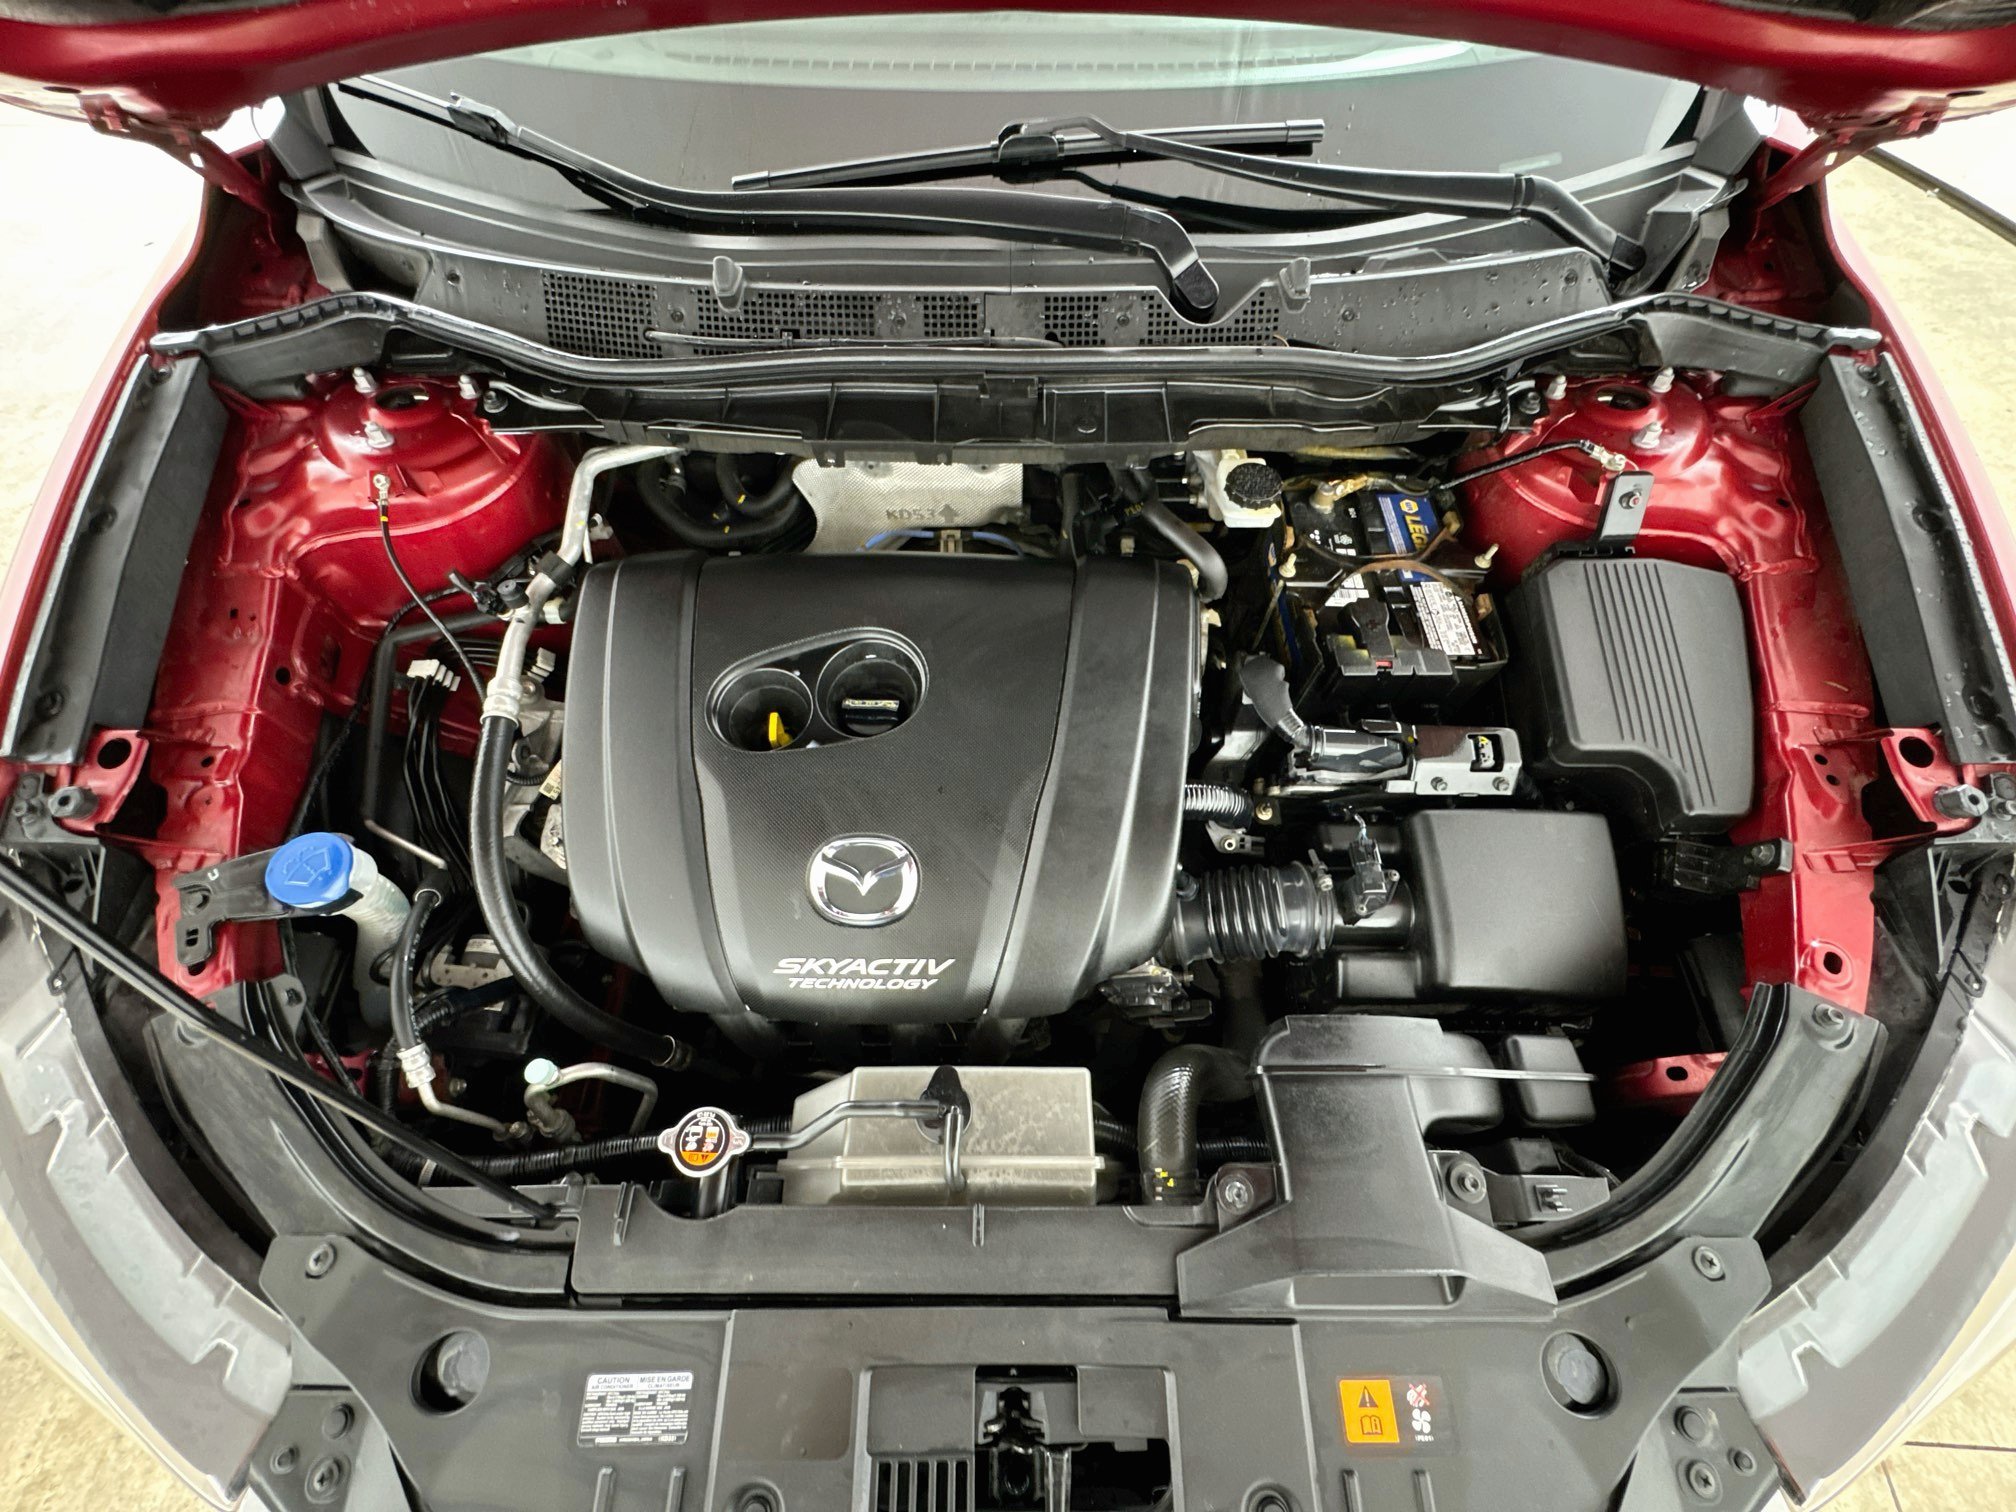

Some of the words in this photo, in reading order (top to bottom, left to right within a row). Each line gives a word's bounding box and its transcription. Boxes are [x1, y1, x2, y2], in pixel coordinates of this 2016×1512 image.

[772, 958, 956, 975] SKYACTIV
[788, 977, 939, 990] TECHNOLOGY
[597, 1376, 631, 1385] CAUTION
